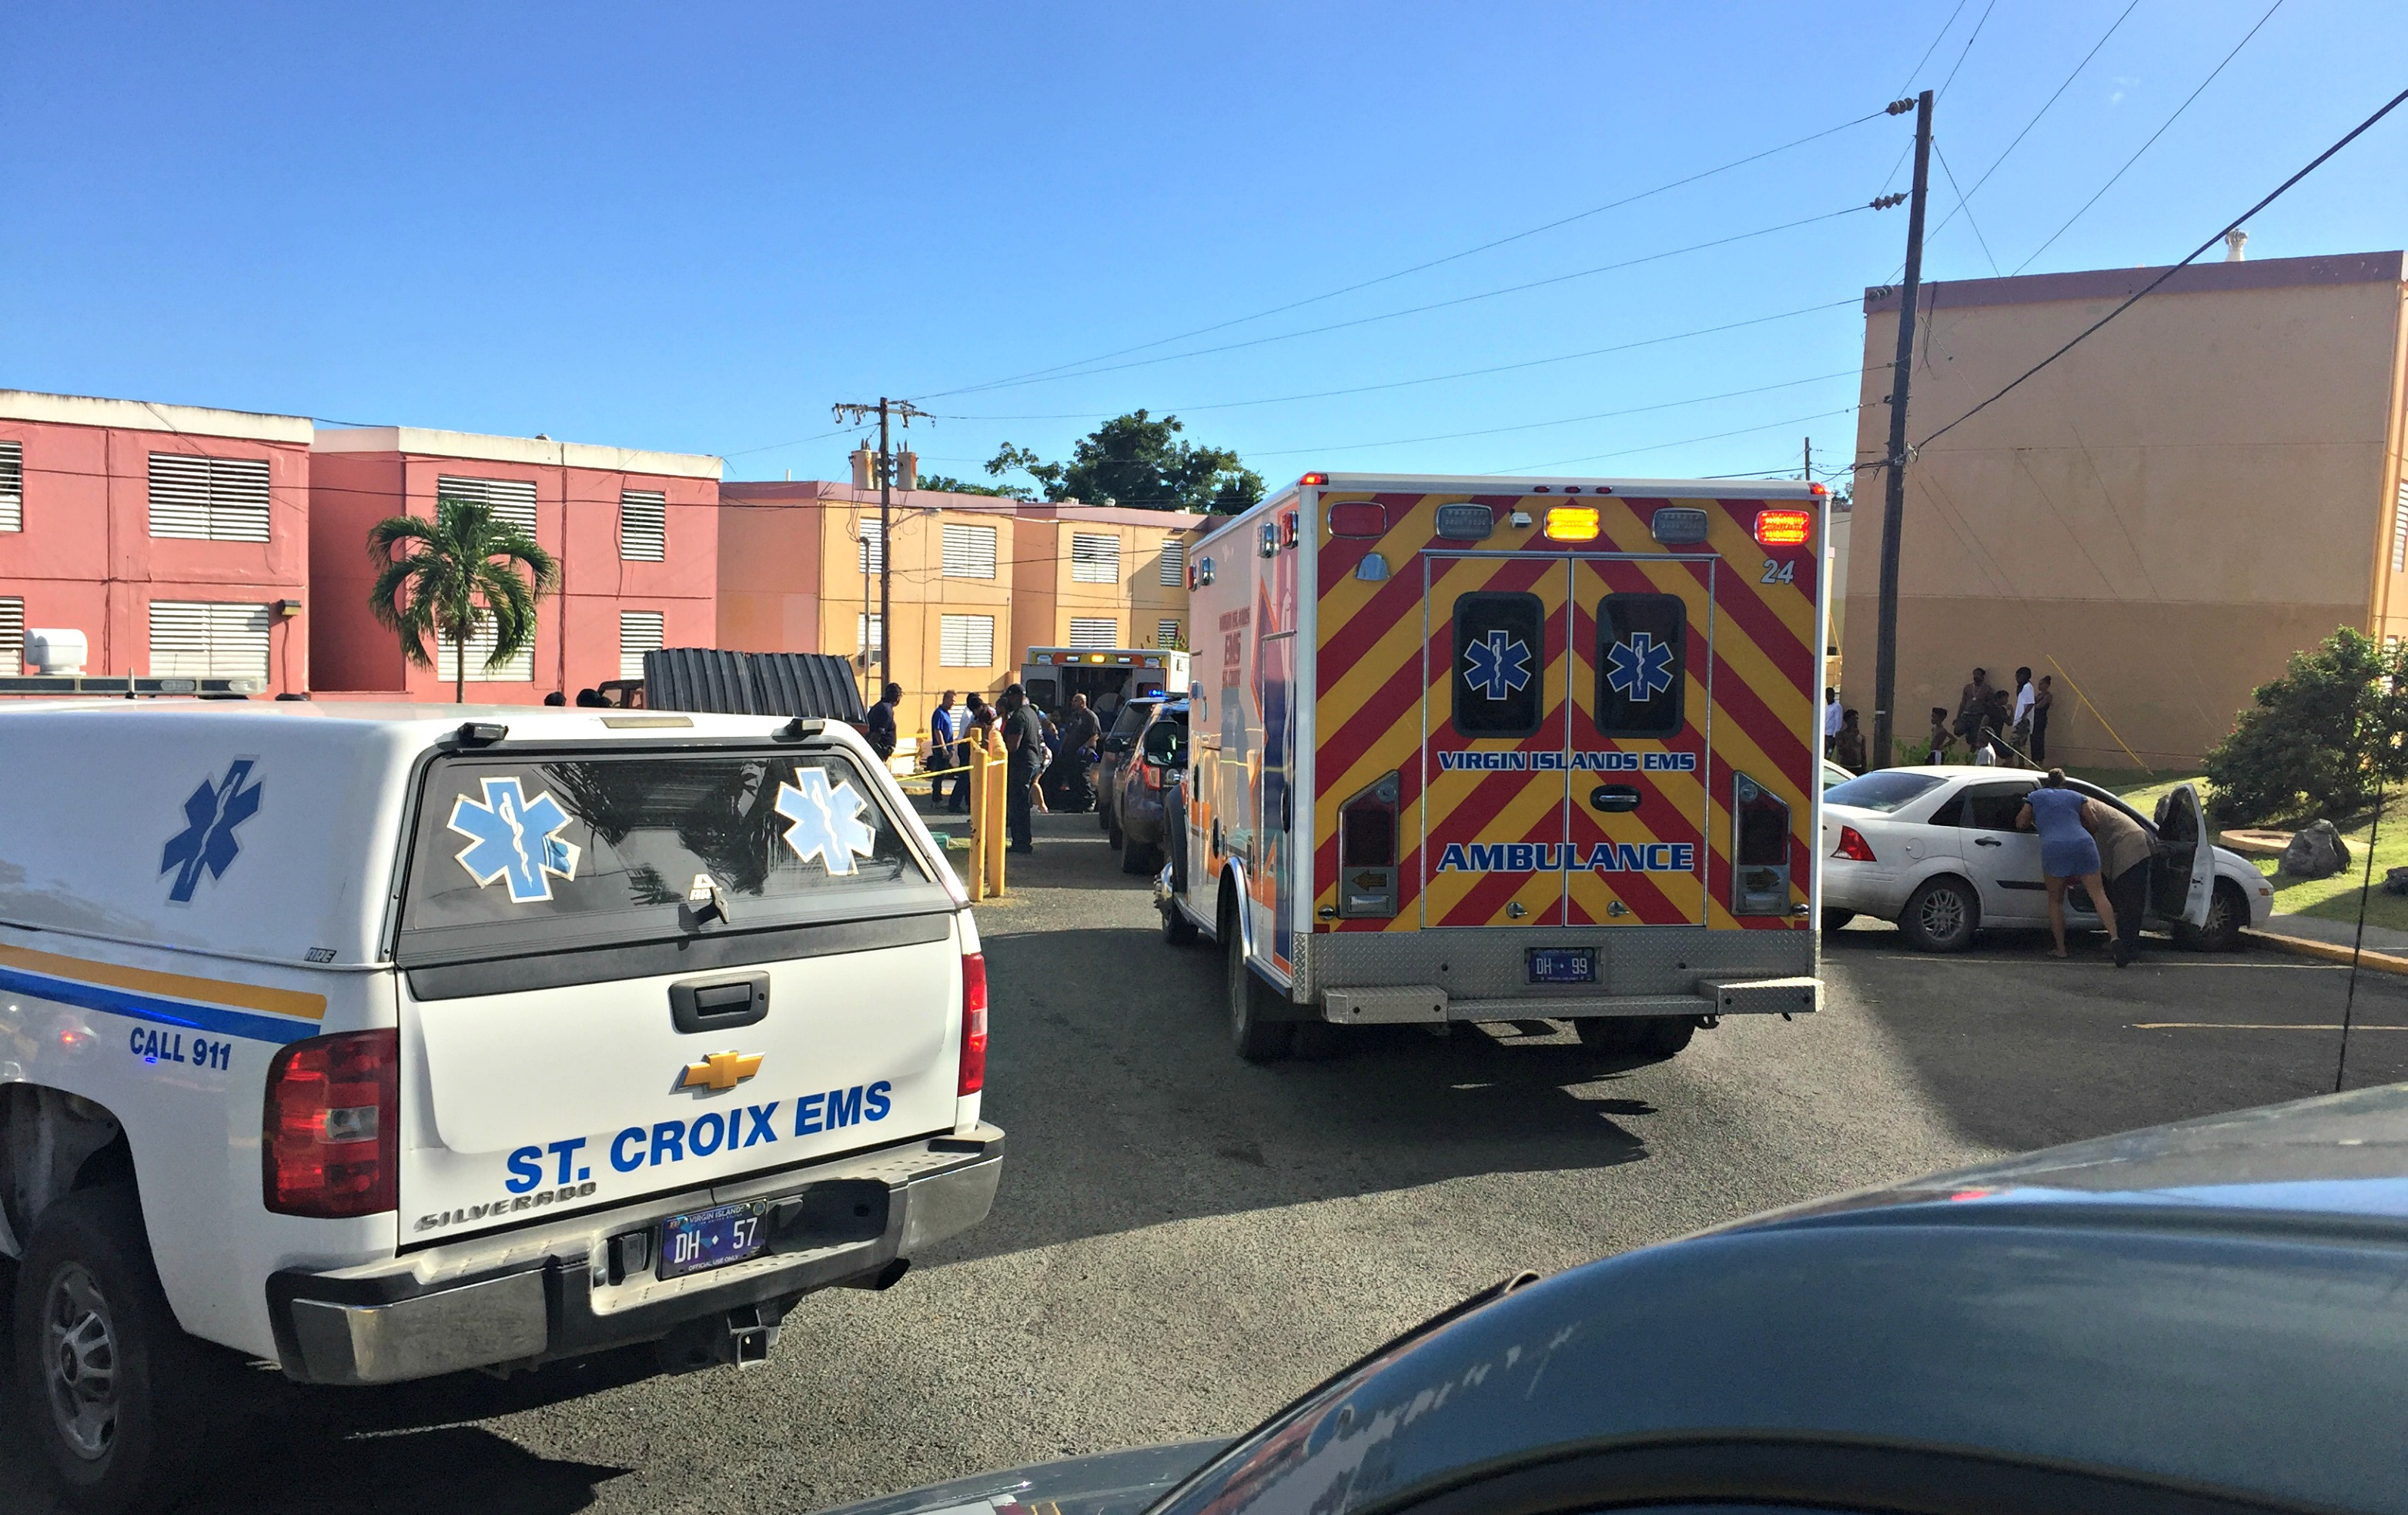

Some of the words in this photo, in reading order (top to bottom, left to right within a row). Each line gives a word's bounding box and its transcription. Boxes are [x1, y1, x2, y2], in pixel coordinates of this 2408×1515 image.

[1761, 559, 1794, 584] 24
[1437, 751, 1527, 771] VIRGIN
[1530, 752, 1639, 771] ISLANDS
[1644, 752, 1696, 771] EMS
[1436, 843, 1694, 872] AMBULANCE
[689, 887, 722, 901] AR
[303, 947, 336, 963] ARE
[1536, 958, 1551, 974] DH
[1571, 958, 1587, 974] 99
[130, 1027, 185, 1062] CALL
[192, 1038, 231, 1071] 911
[505, 1137, 590, 1194] ST.
[610, 1102, 780, 1173] CROIX
[794, 1080, 892, 1137] EMS
[414, 1181, 597, 1232] SILVERADO
[689, 1212, 714, 1223] VIRGIN
[715, 1205, 745, 1218] ISLANDS
[674, 1229, 701, 1263] DH
[733, 1217, 758, 1249] 57
